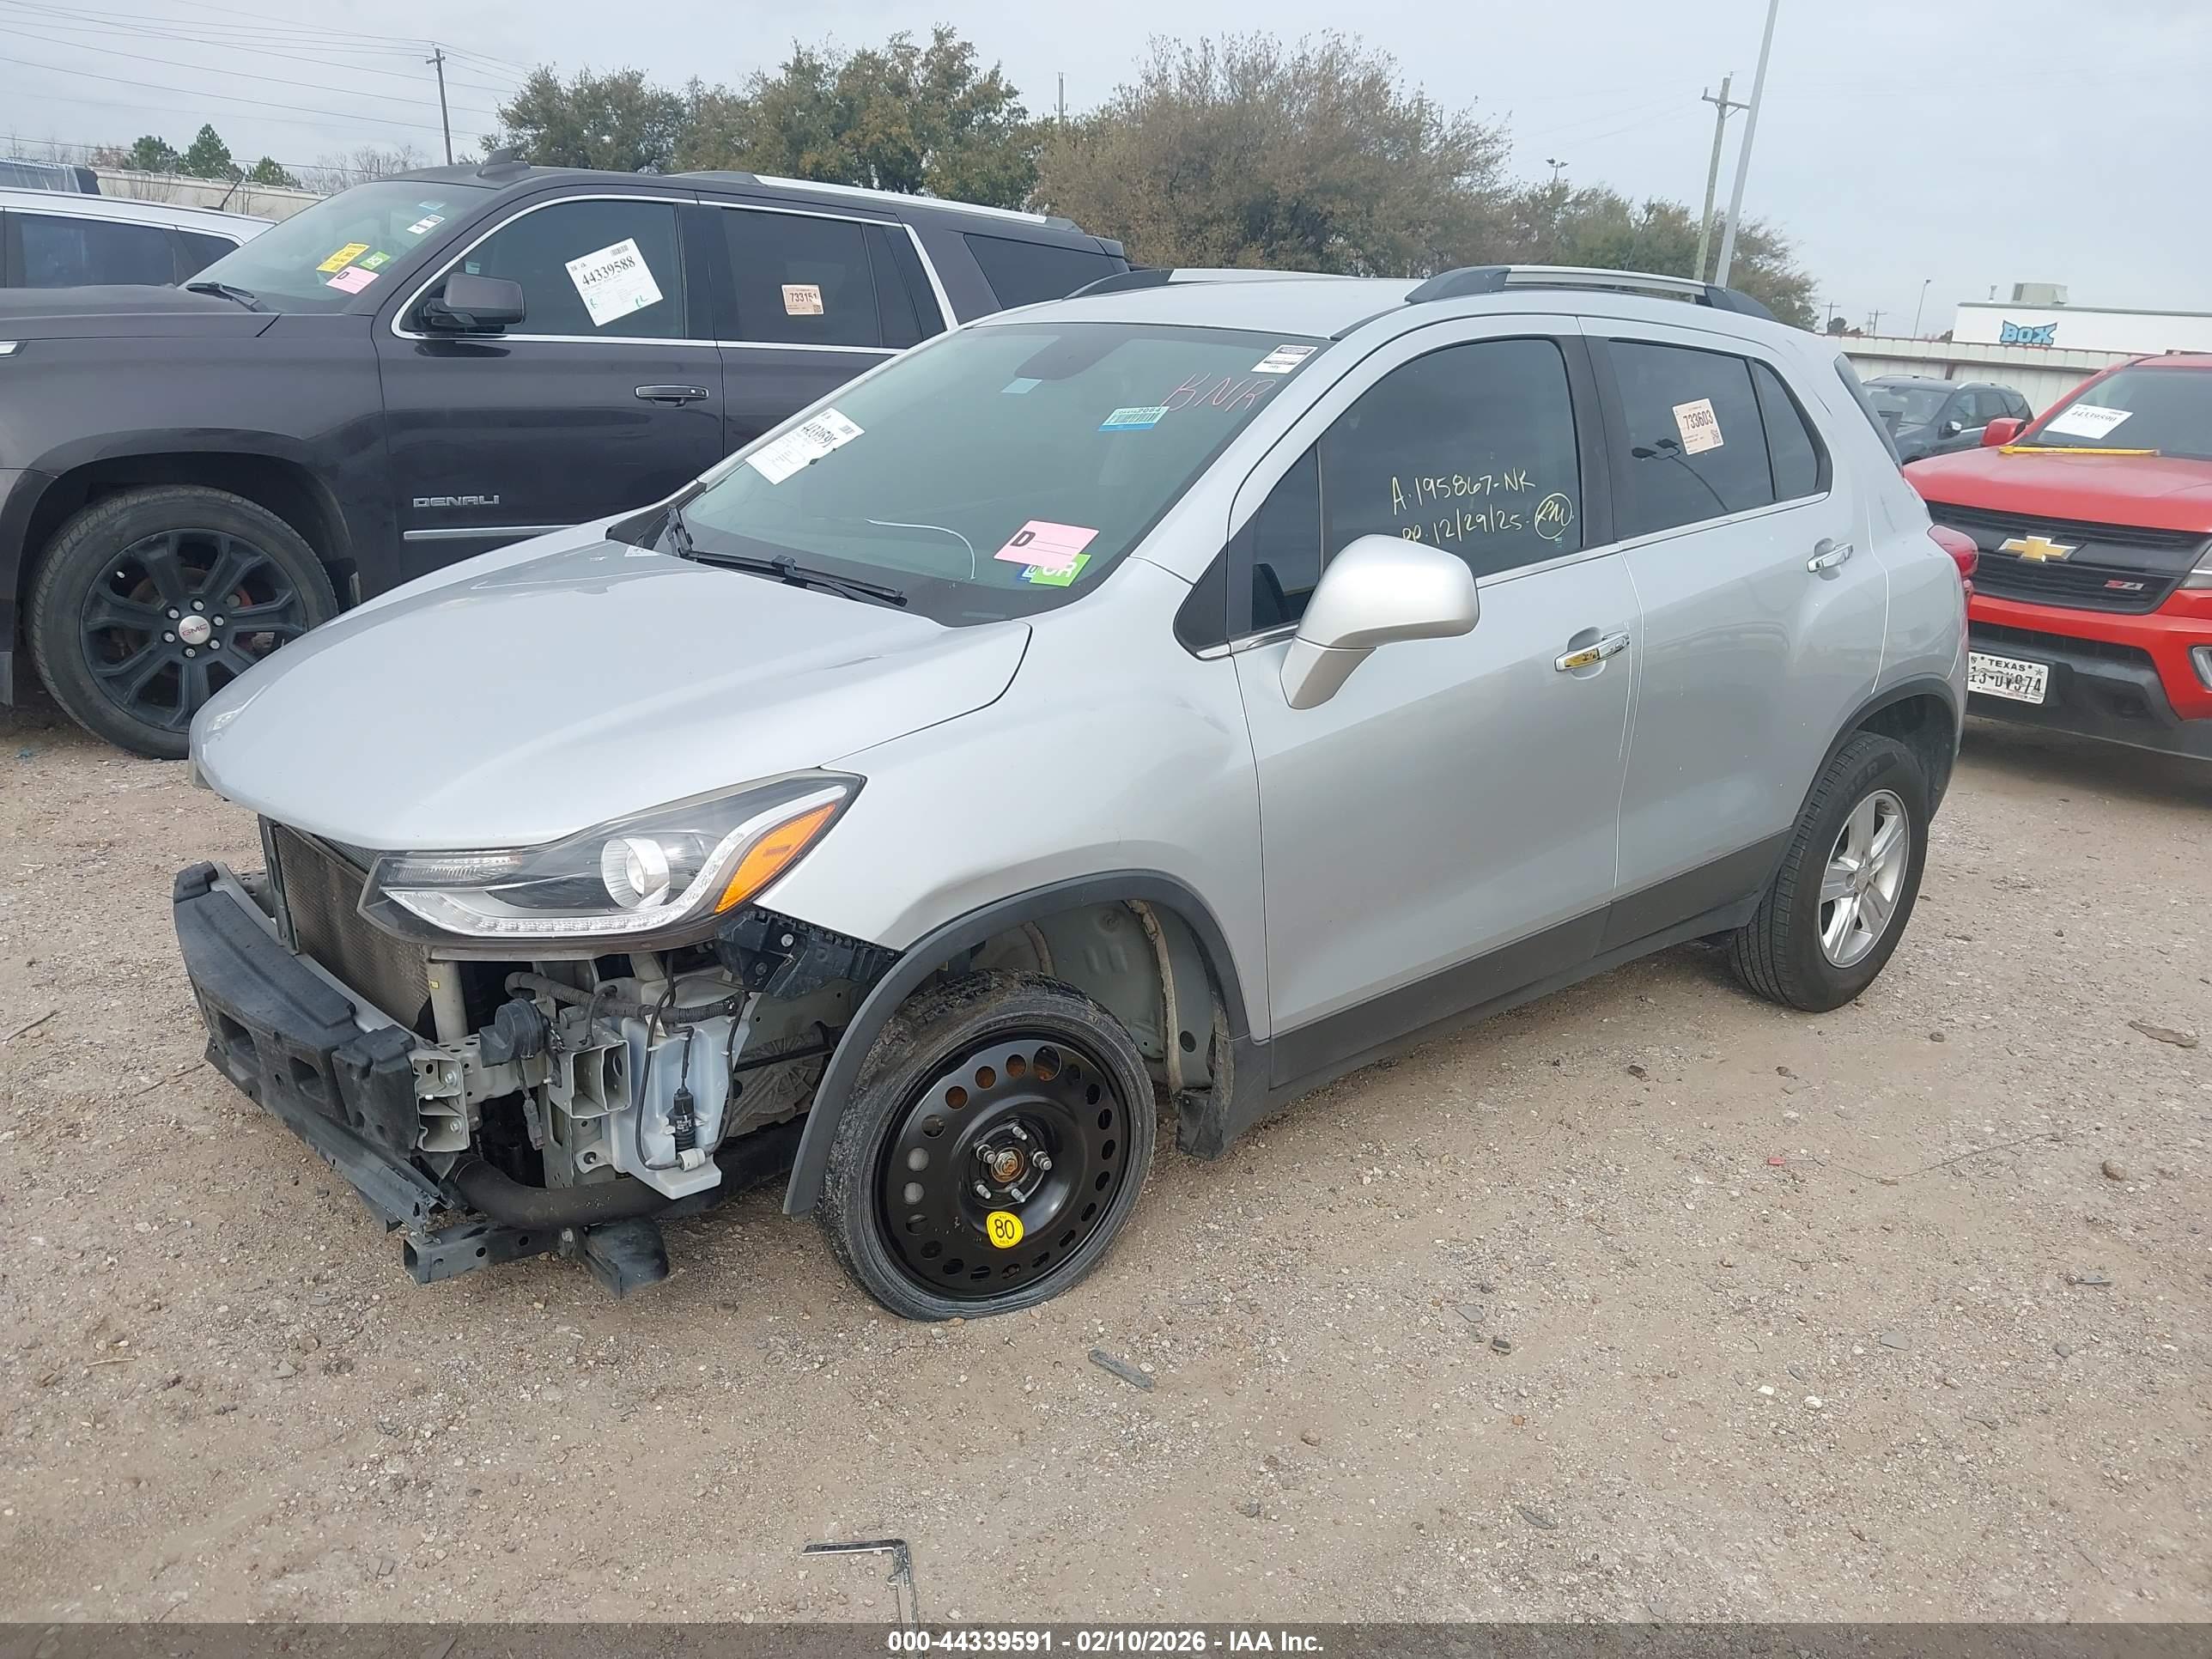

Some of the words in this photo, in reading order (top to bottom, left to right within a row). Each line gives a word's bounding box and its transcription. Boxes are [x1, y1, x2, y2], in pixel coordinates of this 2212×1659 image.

[581, 255, 635, 286] 44339588
[789, 292, 817, 302] 733151
[1999, 319, 2057, 345] BOX
[1682, 410, 1713, 430] 733603
[413, 495, 500, 507] DENALI
[1009, 530, 1036, 547] D
[2104, 580, 2144, 591] Z71
[181, 623, 207, 637] GMC
[1987, 659, 2027, 672] TEXAS
[994, 1218, 1015, 1239] 80
